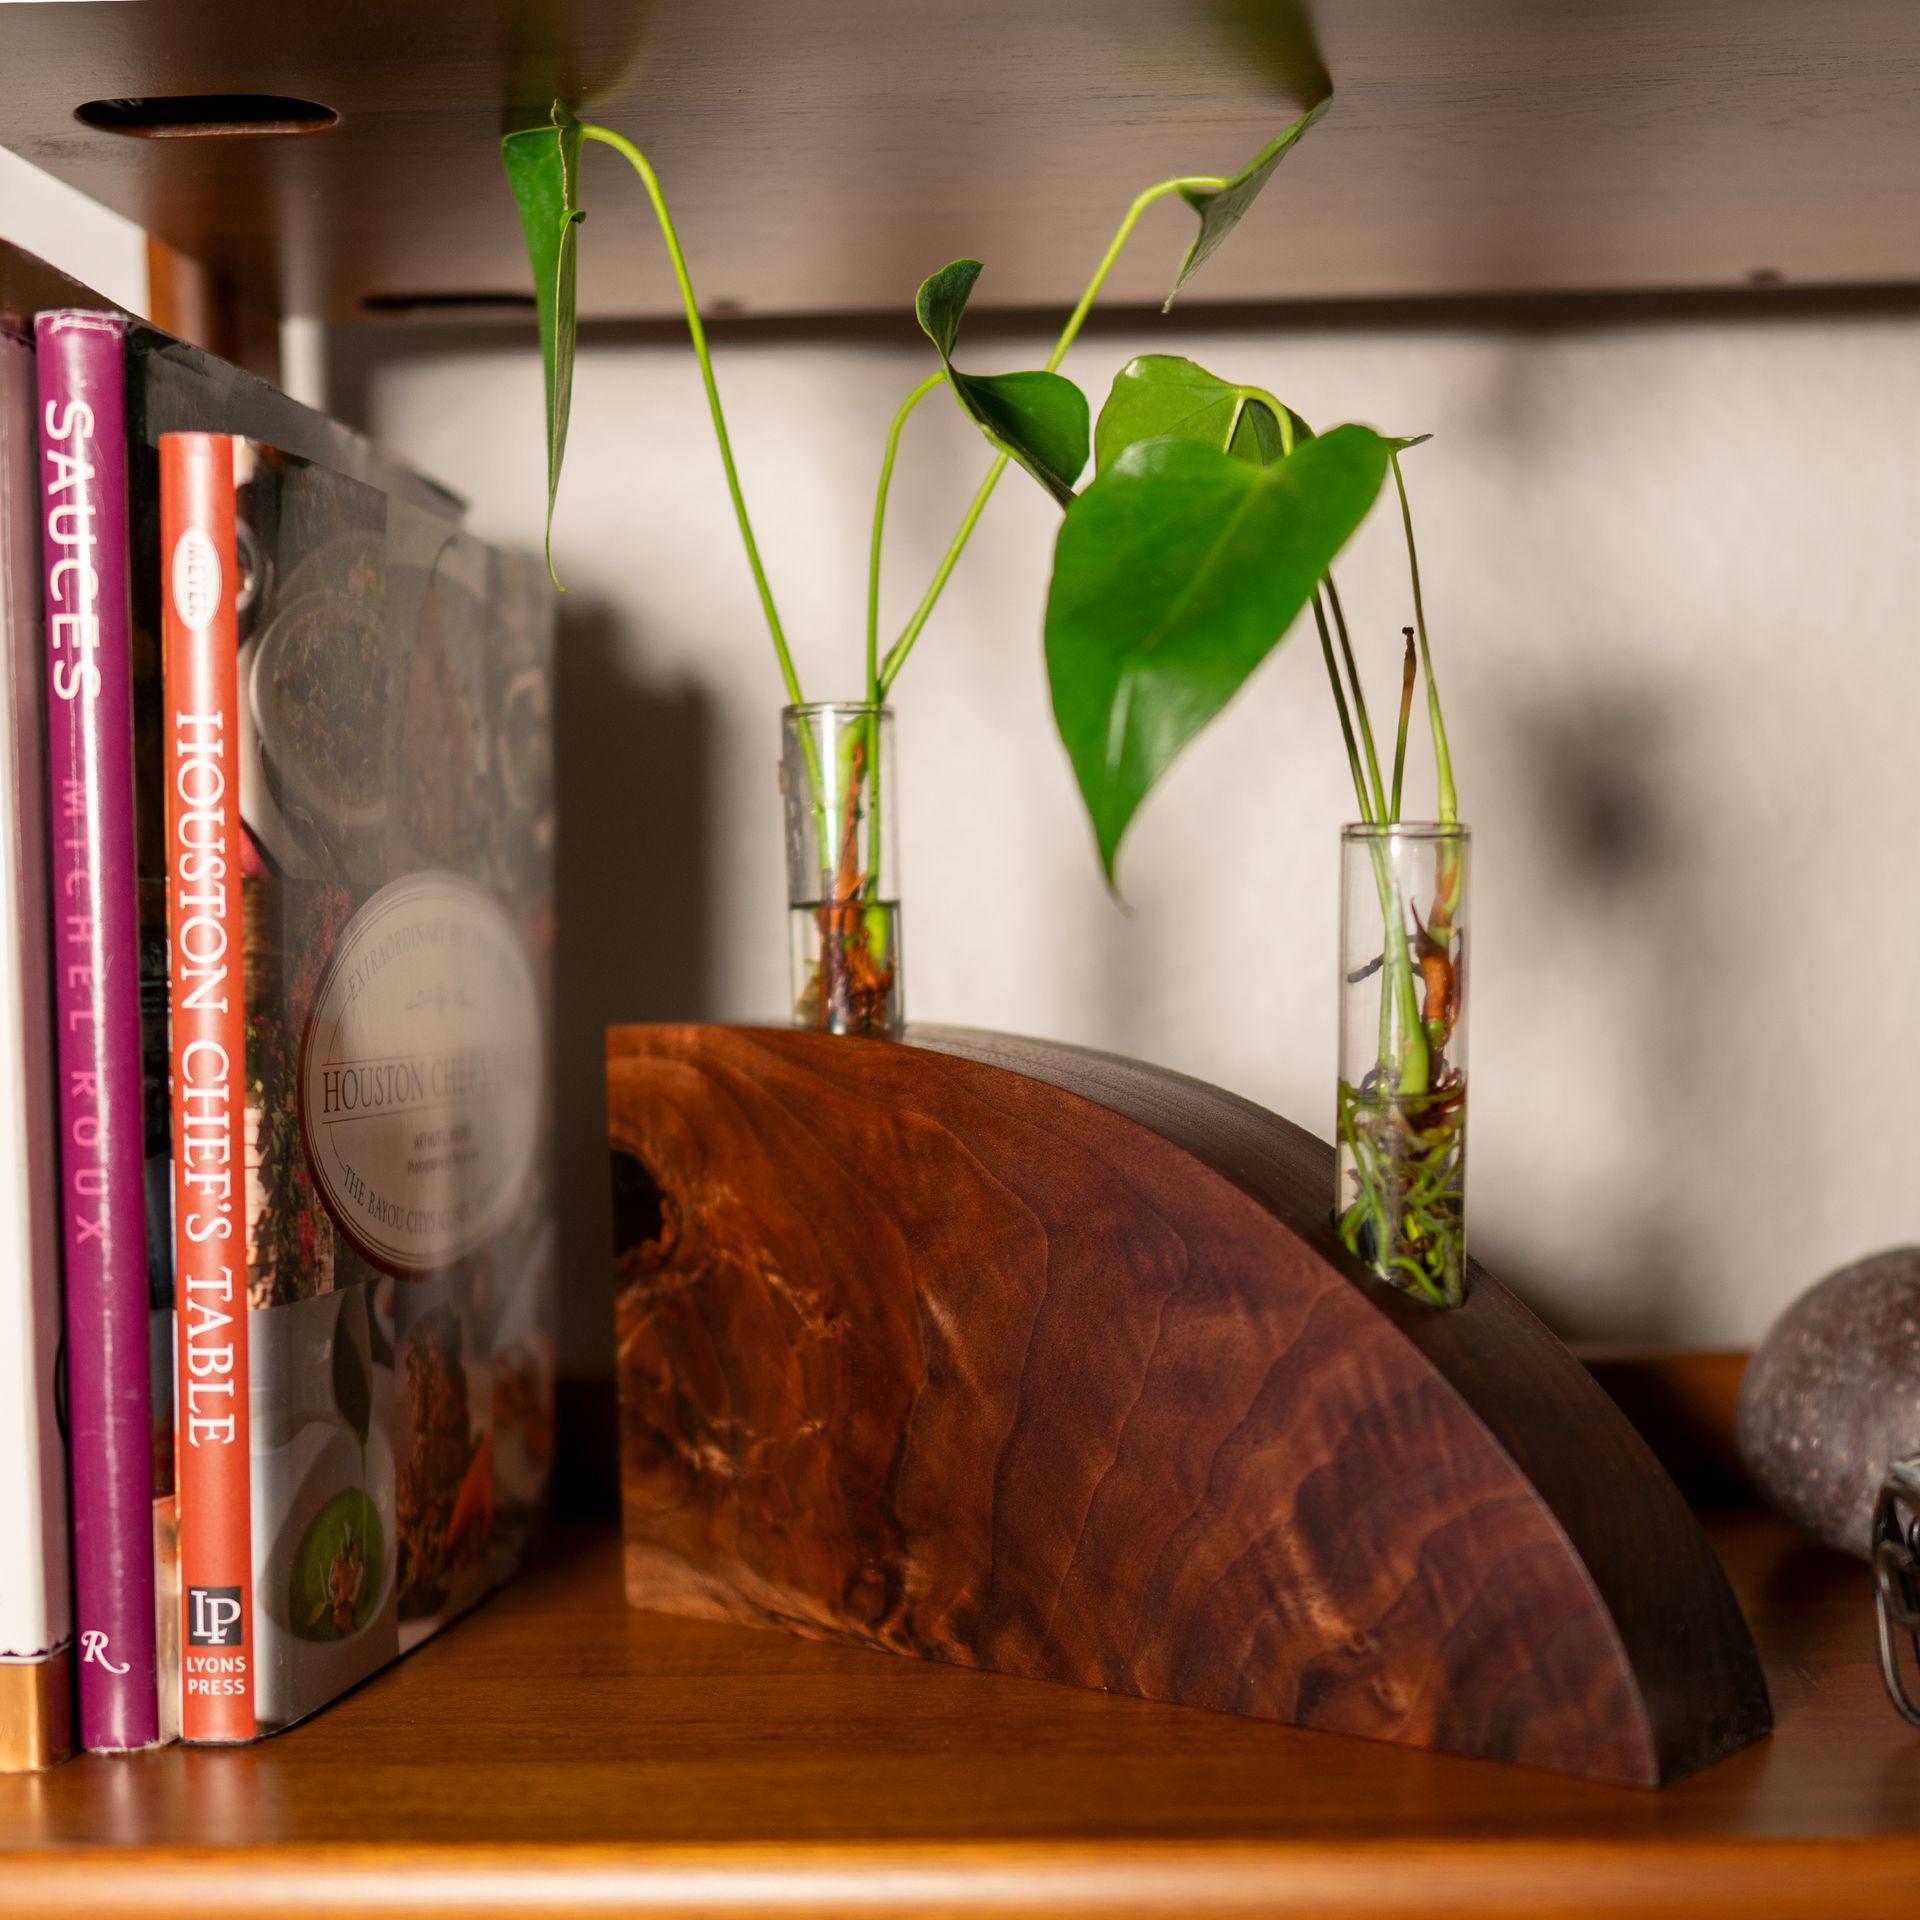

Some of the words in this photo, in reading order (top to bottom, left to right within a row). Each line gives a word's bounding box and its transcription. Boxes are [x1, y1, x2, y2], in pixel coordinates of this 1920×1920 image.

[45, 399, 101, 700] SAUCES
[62, 779, 97, 1033] MICHEL
[176, 709, 229, 1014] HOUSTON
[181, 1040, 233, 1243] CHEF'S
[322, 1062, 425, 1113] HOUSTON
[70, 1070, 108, 1249] ROUX
[344, 1164, 366, 1206] THE
[368, 1191, 405, 1231] BAYOU
[186, 1265, 235, 1448] TABLE
[81, 1630, 131, 1674] R
[186, 1656, 247, 1674] LYONS
[191, 1590, 242, 1644] LP
[187, 1678, 247, 1696] PRESS
